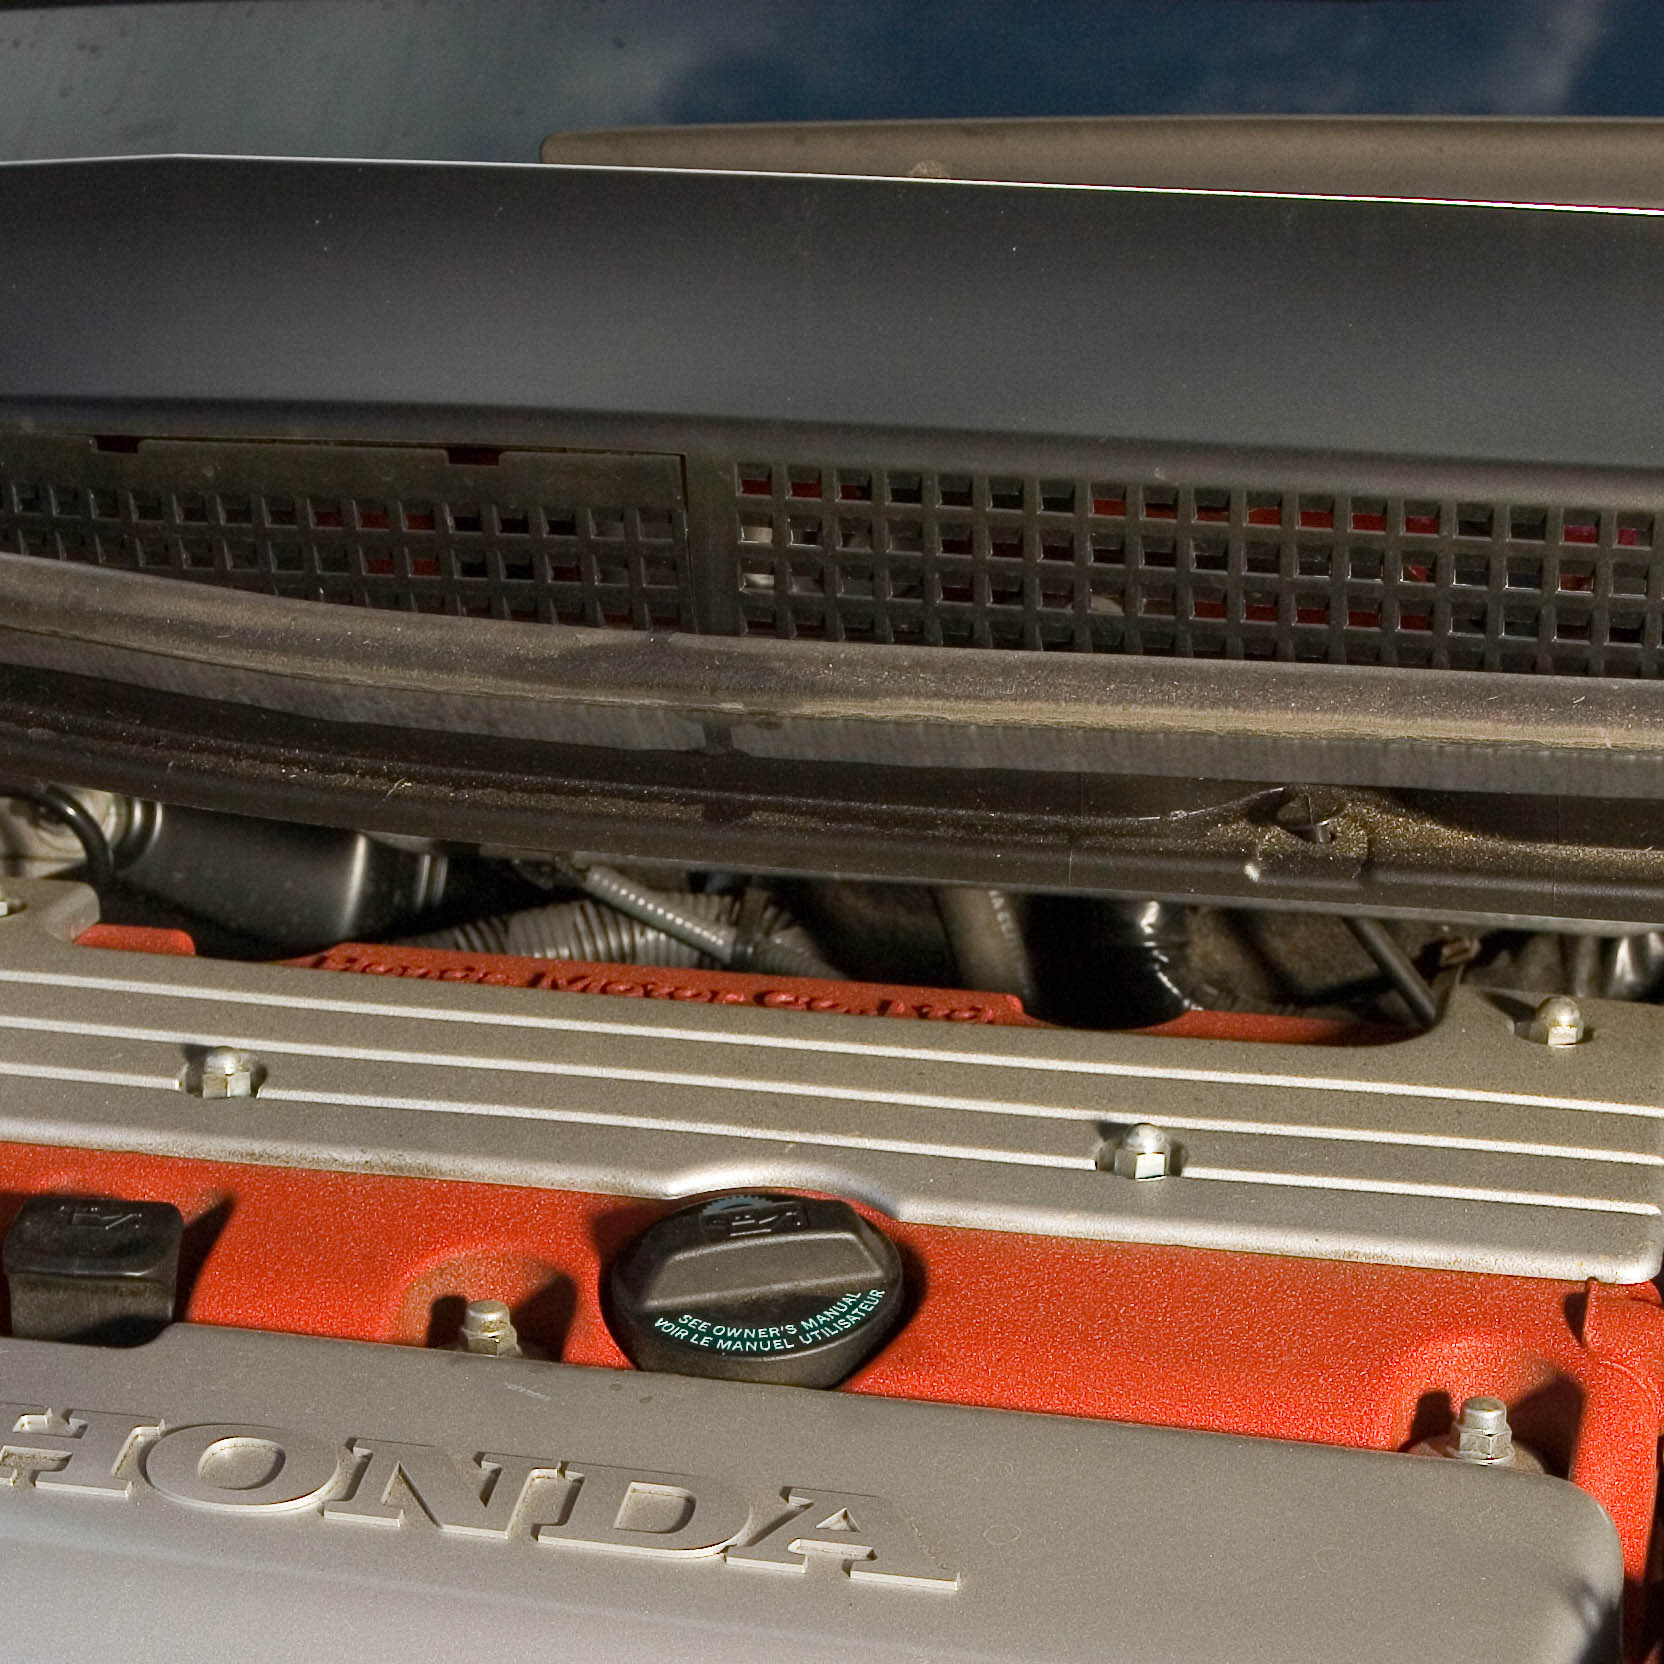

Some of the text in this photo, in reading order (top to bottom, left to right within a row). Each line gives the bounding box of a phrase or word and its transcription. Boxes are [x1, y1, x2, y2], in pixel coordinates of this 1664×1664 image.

[653, 1287, 886, 1353] VOIR LE MANUEL UTILISATEUR
[677, 1290, 862, 1339] SEE OWNER'S MANUAL
